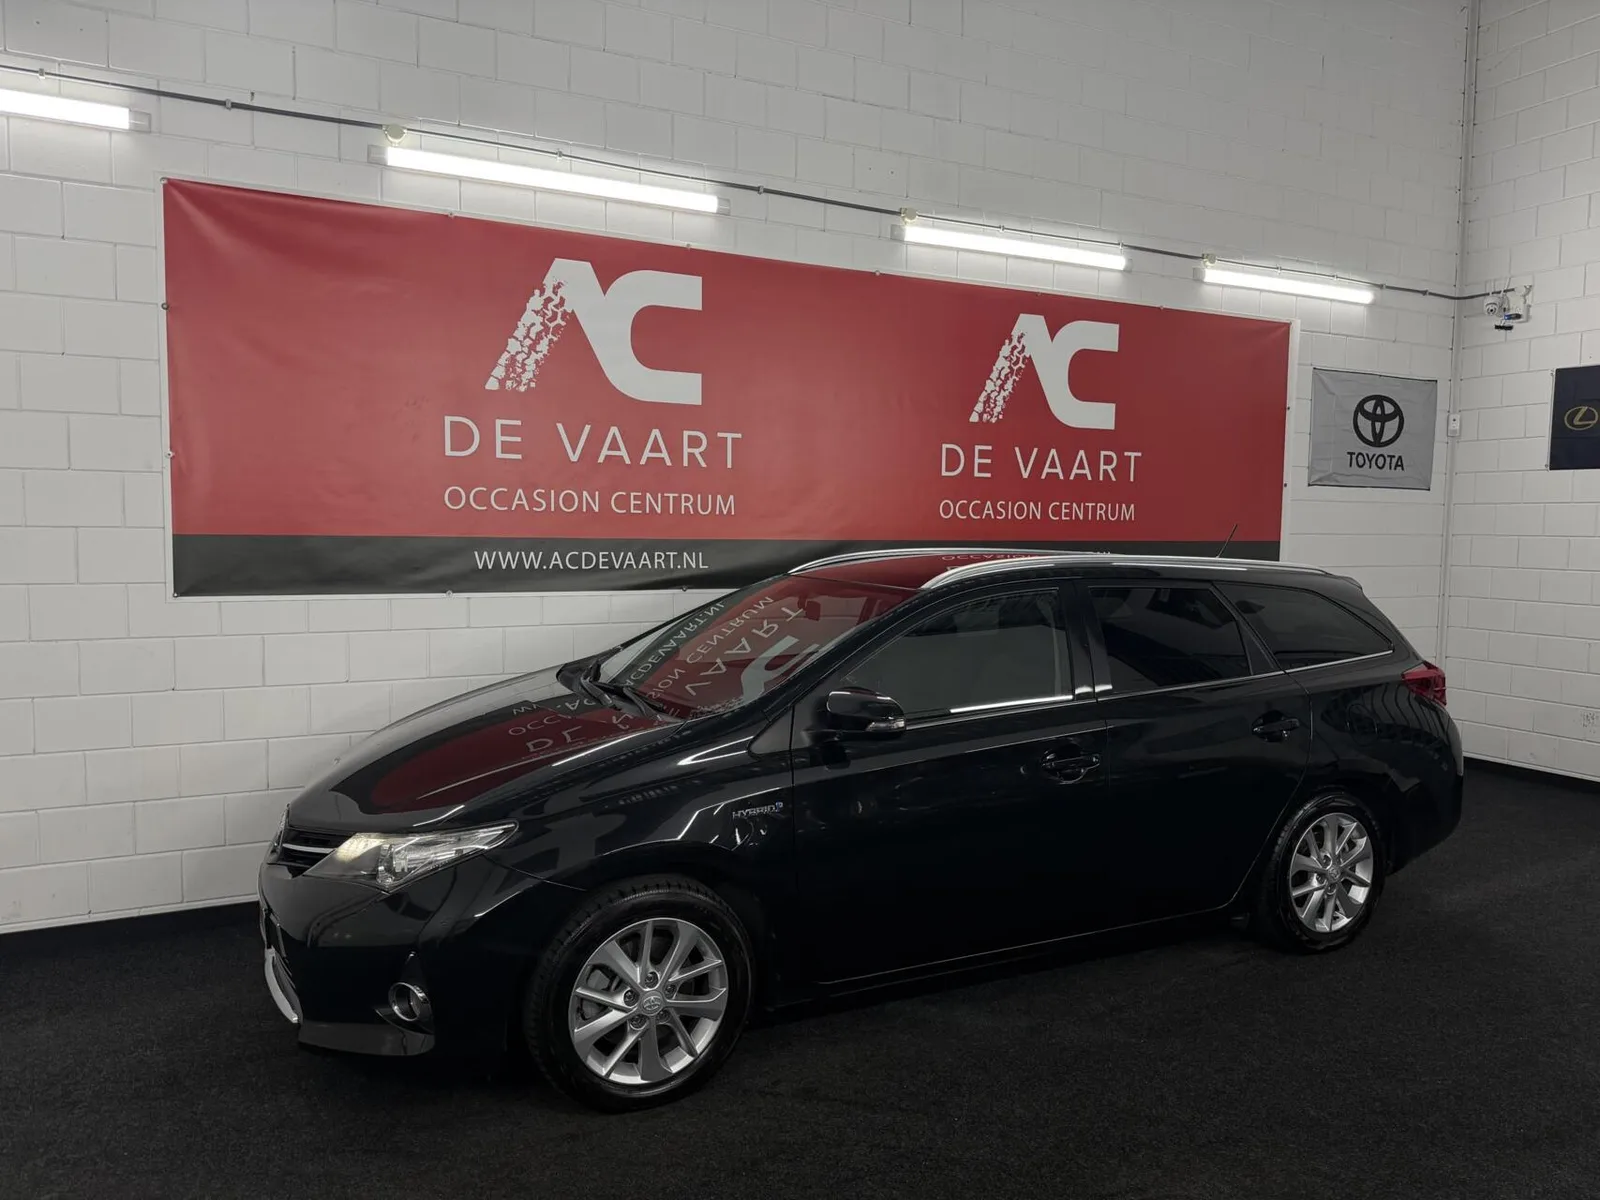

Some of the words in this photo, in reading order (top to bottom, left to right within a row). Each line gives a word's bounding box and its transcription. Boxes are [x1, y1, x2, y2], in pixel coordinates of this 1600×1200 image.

[485, 258, 703, 405] AC
[969, 313, 1120, 430] AC
[444, 415, 522, 460] DE
[555, 422, 742, 469] VAART
[941, 443, 992, 478] DE
[1014, 446, 1142, 482] VAART
[1347, 452, 1404, 471] TOYOTA
[444, 486, 600, 513] OCCASION
[610, 491, 736, 515] CENTRUM
[939, 500, 1042, 520] OCCASION
[1048, 501, 1135, 521] CENTRUM
[474, 551, 709, 570] WWW.ACDEVAART.NL
[732, 804, 777, 819] HYBRID
